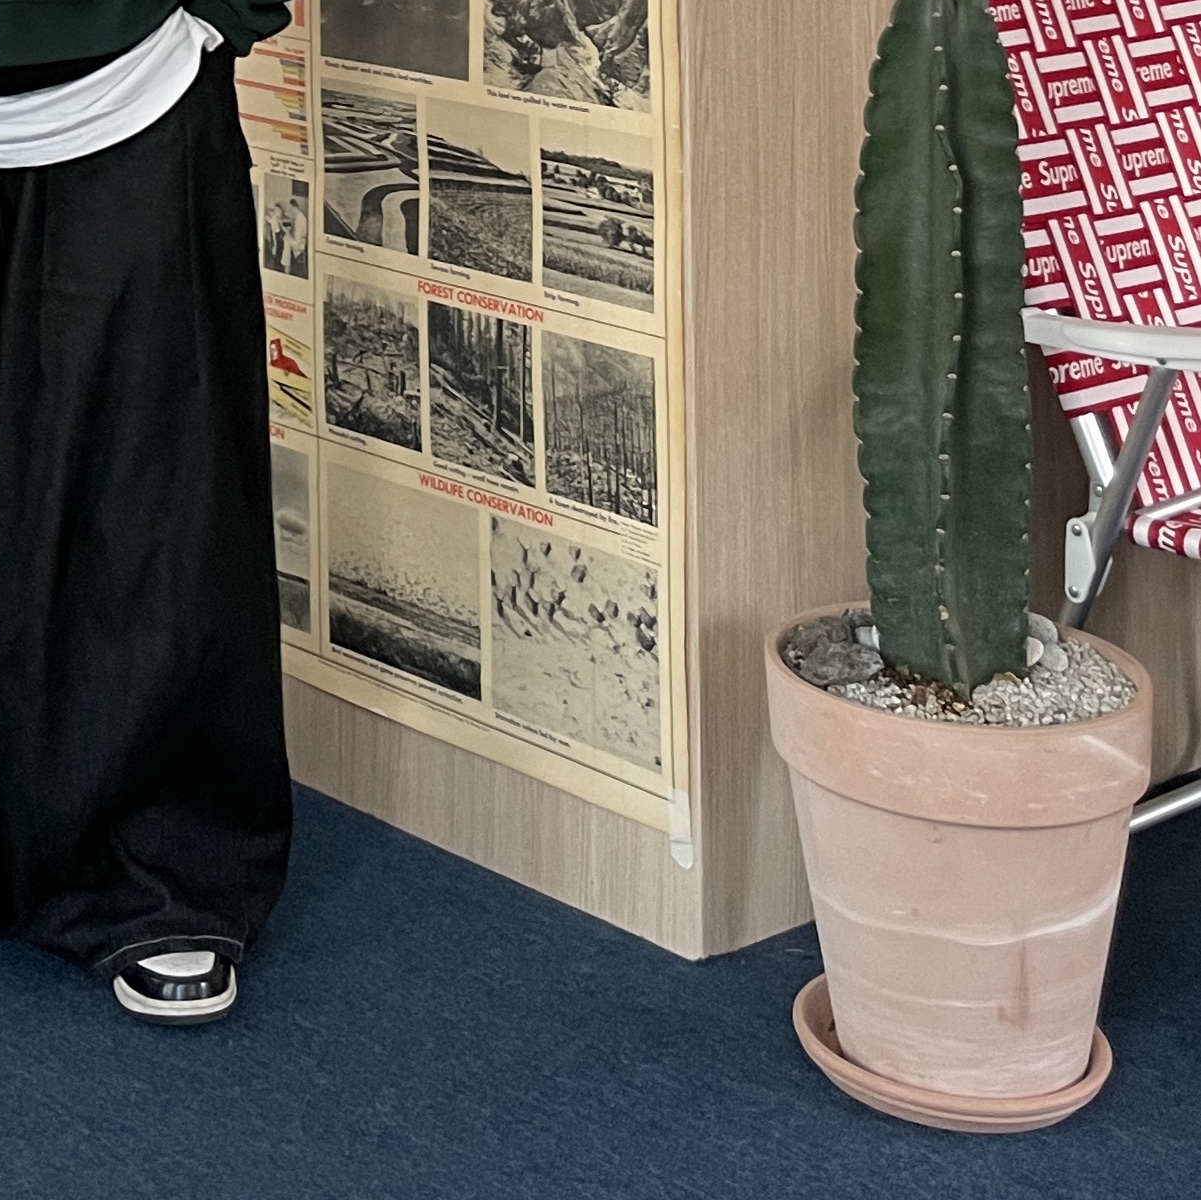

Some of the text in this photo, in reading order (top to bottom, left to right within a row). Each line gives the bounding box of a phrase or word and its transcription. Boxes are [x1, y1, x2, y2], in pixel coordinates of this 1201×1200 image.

[418, 280, 454, 299] FOREST
[457, 290, 544, 323] CONSERVATION
[419, 473, 464, 499] WILDLIFE
[467, 488, 553, 527] CONSERVATION
